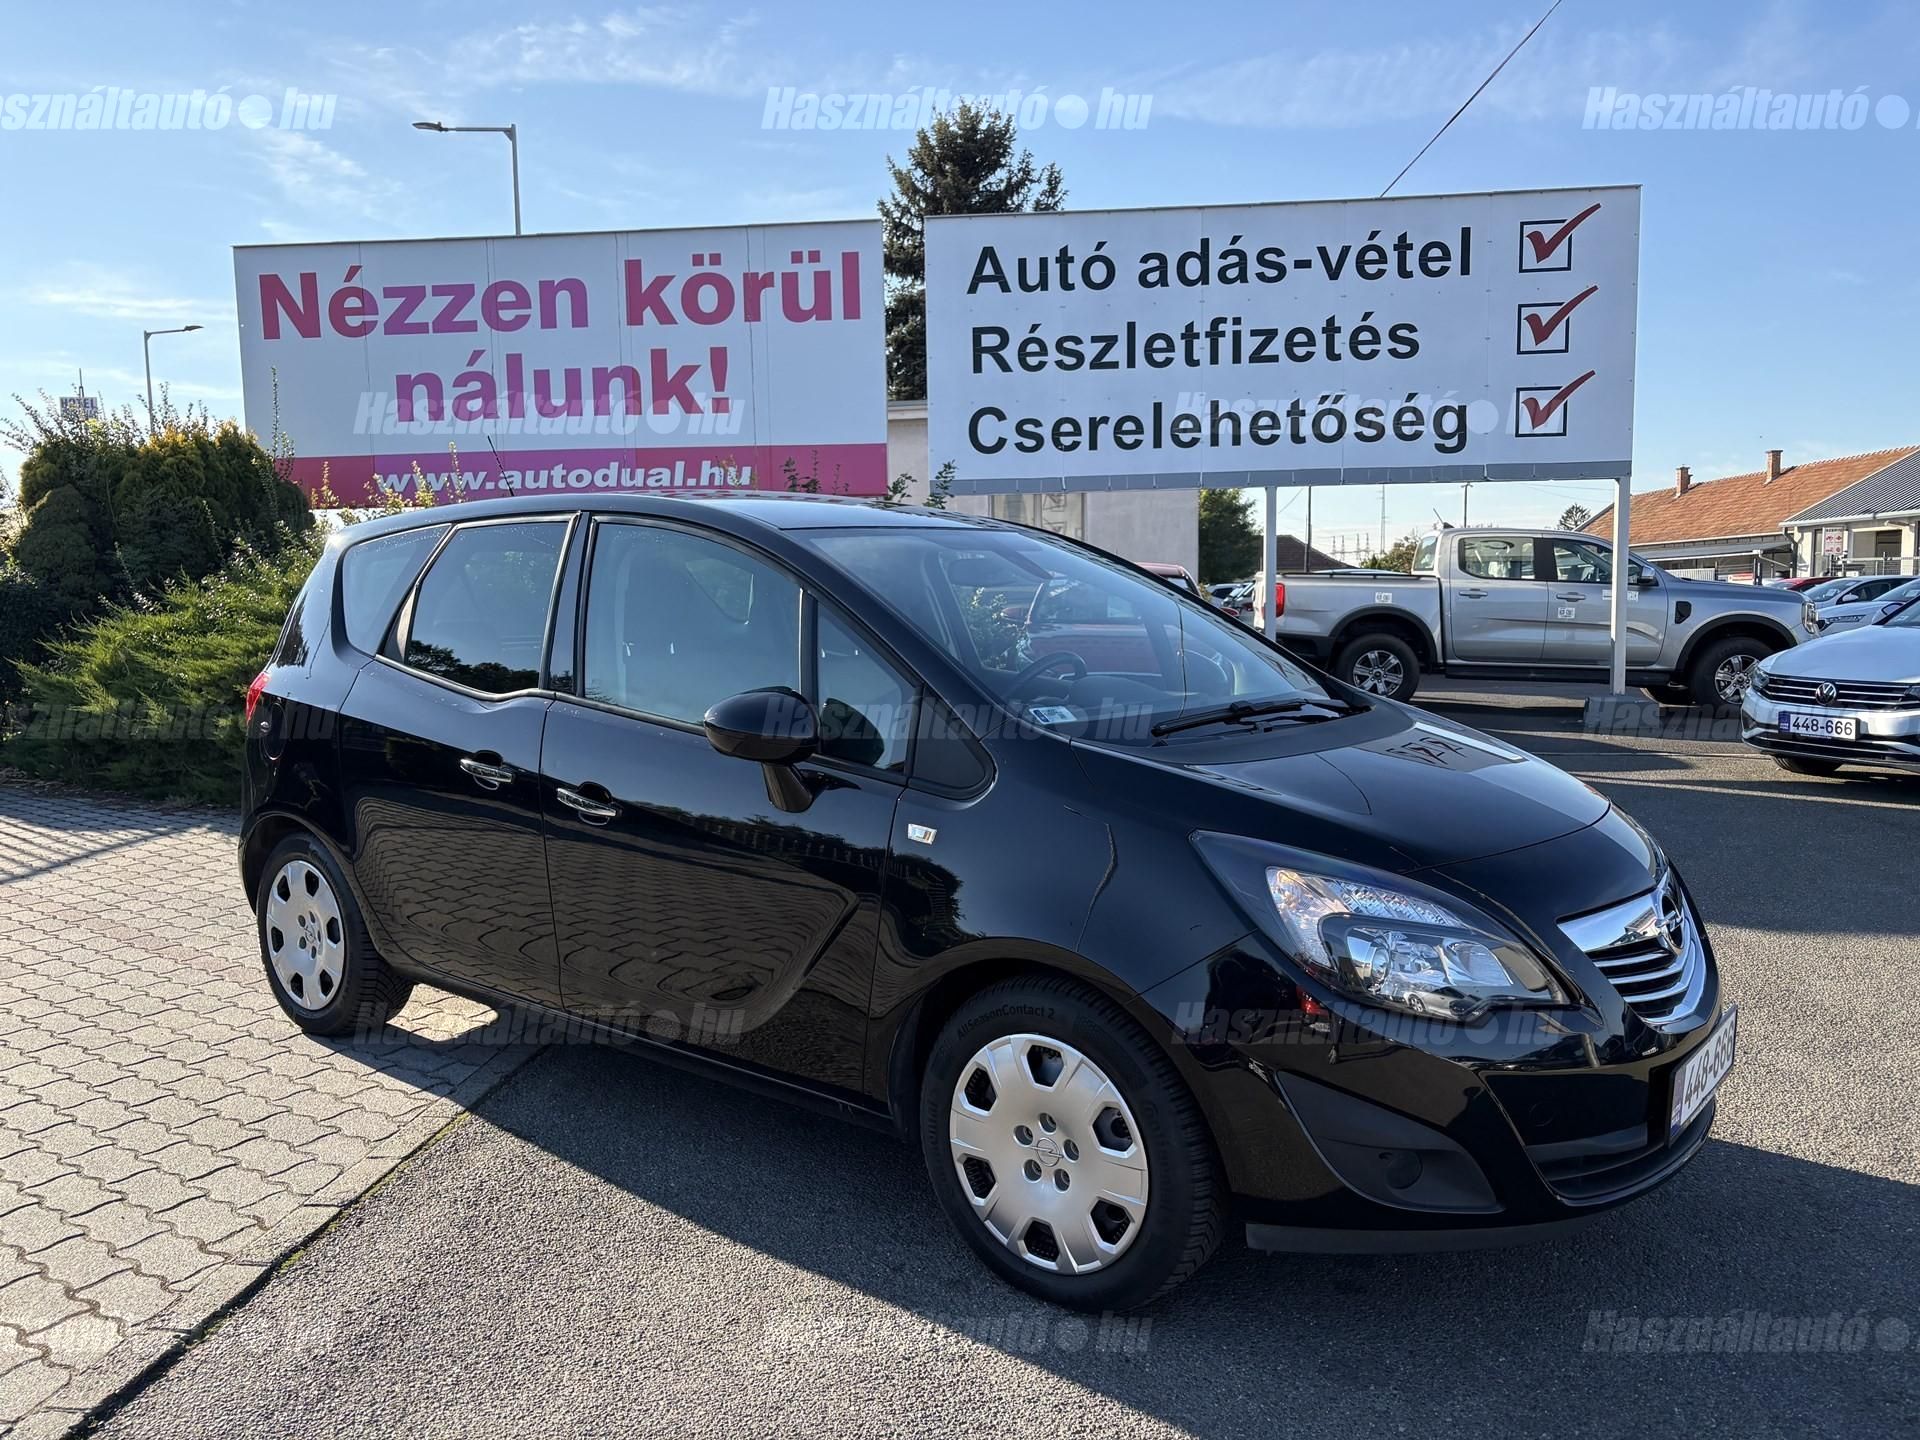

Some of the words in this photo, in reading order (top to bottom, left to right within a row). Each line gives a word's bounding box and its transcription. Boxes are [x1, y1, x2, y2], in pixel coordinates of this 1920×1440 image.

[967, 241, 1116, 294] Autó
[1138, 227, 1472, 288] adás-vétel
[260, 265, 588, 340] Nézzen
[624, 250, 861, 327] körül
[972, 312, 1420, 374] Részletfizetés
[394, 346, 729, 424] nálunk!
[968, 393, 1467, 455] Cserelehetőség
[378, 459, 752, 493] www.autodual.hu
[1792, 716, 1853, 736] 448-666
[1685, 1020, 1734, 1110] 448-666
